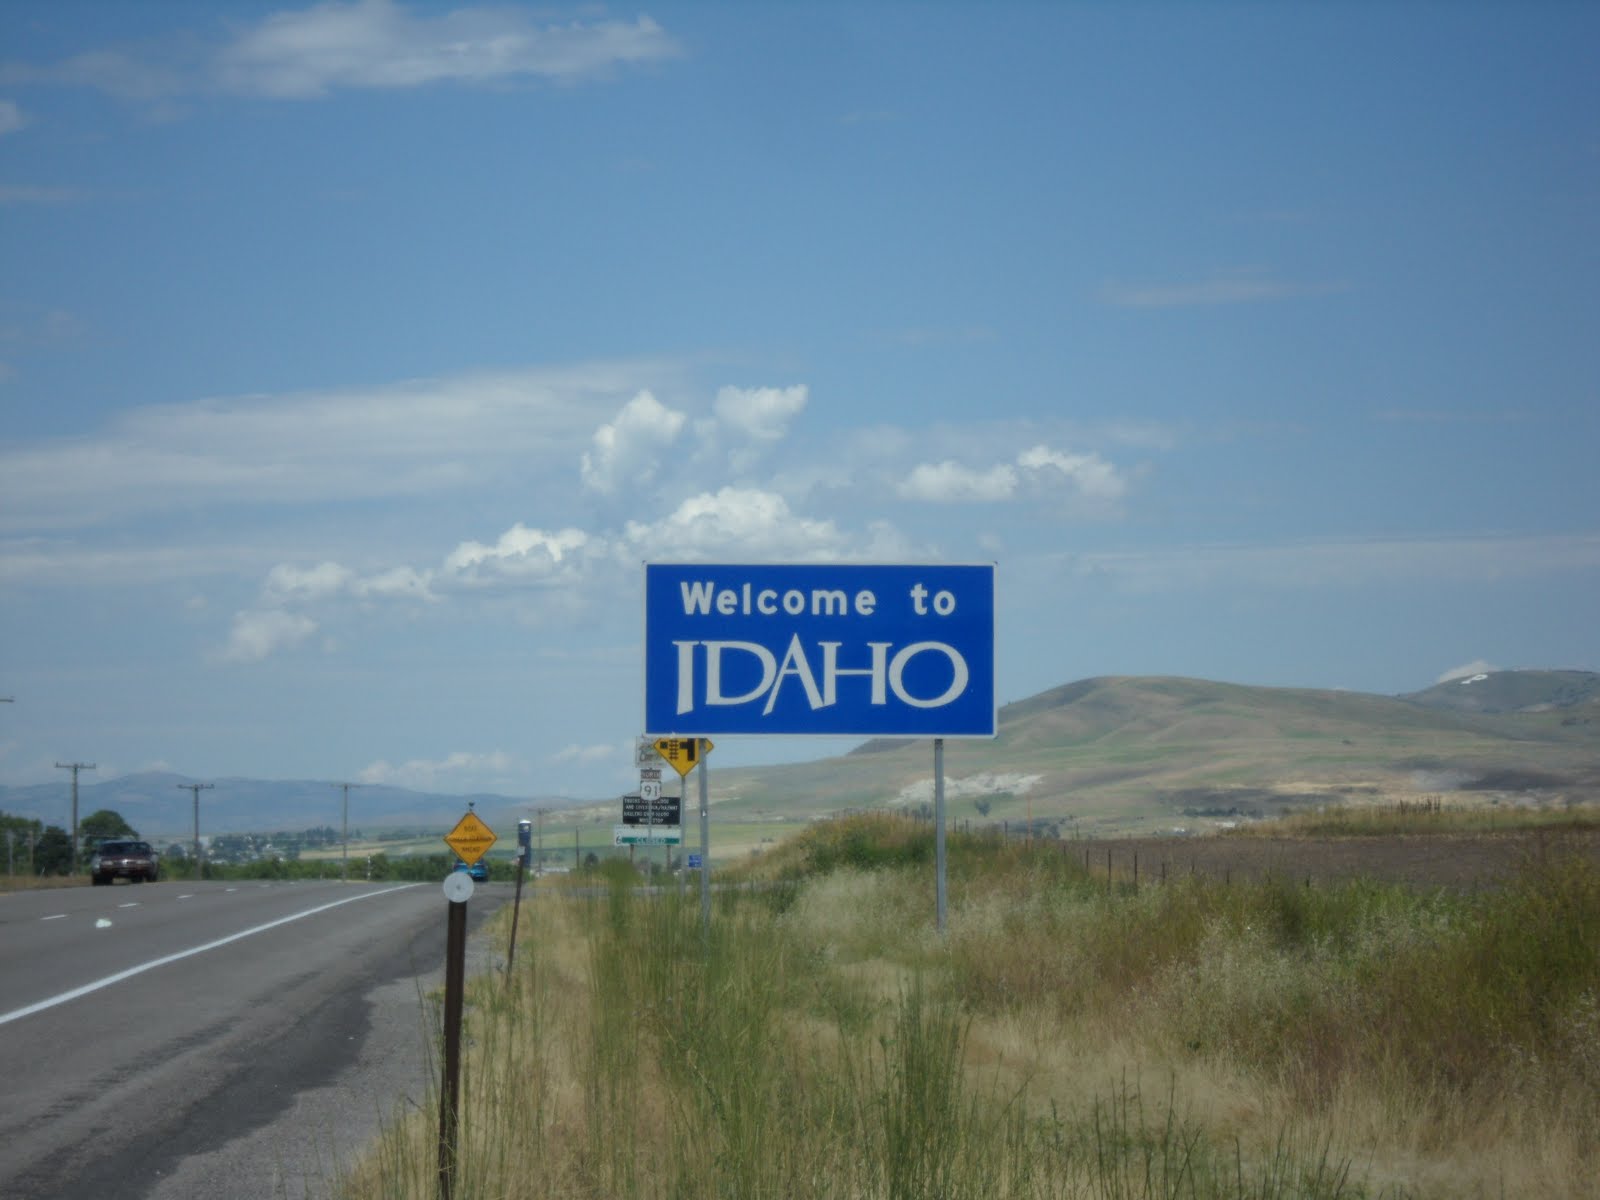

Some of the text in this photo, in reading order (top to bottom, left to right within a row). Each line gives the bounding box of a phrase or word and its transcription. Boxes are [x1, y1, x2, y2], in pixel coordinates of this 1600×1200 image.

[680, 581, 956, 616] Welcome to
[672, 632, 969, 716] IDAHO
[644, 785, 658, 796] 91
